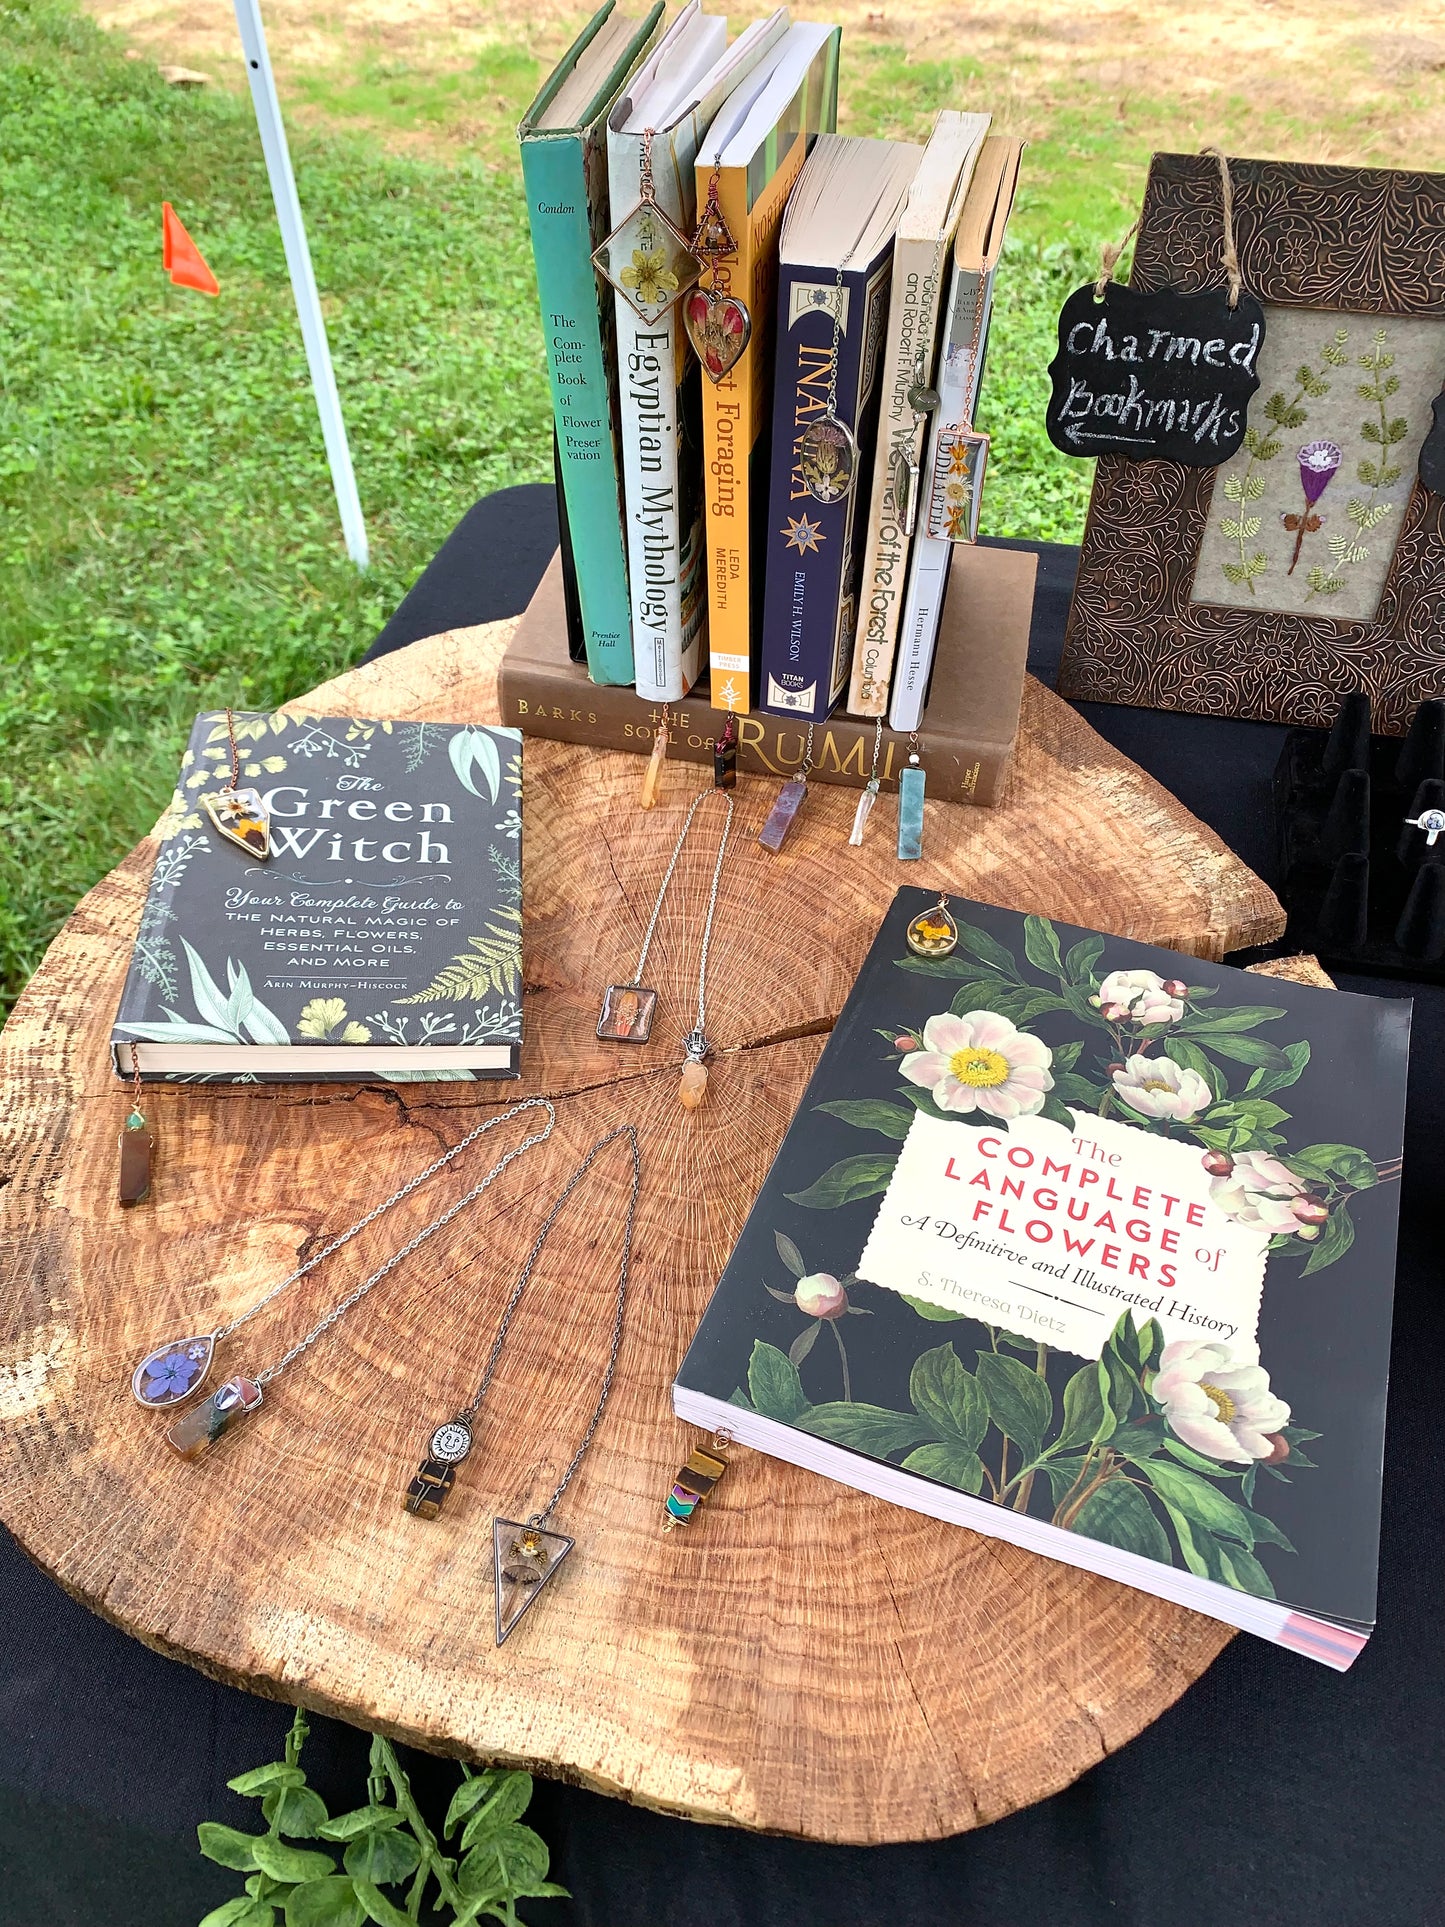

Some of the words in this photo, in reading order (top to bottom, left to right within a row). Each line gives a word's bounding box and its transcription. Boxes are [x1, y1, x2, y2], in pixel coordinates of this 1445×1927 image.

[538, 202, 575, 214] Condon
[904, 272, 919, 304] and
[550, 315, 576, 328] The
[900, 308, 918, 355] Robert
[553, 337, 587, 350] Com-
[1066, 317, 1260, 377] Charmed
[554, 353, 583, 366] plete
[557, 372, 587, 386] Book
[560, 394, 572, 406] of
[628, 329, 671, 473] Egyptian
[888, 369, 909, 422] Murphy
[1057, 374, 1240, 446] Bookmarks
[562, 416, 602, 428] Flower
[566, 436, 602, 448] Preser-
[567, 449, 601, 460] vation
[711, 401, 741, 517] Foraging
[929, 422, 958, 536] SDDHARTHA
[879, 525, 902, 549] of
[635, 484, 676, 633] Mythology
[729, 549, 740, 580] LEDA
[874, 551, 901, 587] the
[716, 547, 727, 610] MEREDITH
[793, 571, 805, 605] EMILY
[792, 606, 803, 617] H.
[866, 588, 896, 646] Forest
[592, 631, 621, 639] Prentice
[789, 619, 802, 662] WILSON
[911, 607, 929, 657] Hermann
[781, 679, 804, 689] BOOKS
[782, 673, 804, 683] TITAN
[861, 649, 880, 700] Columbia
[906, 661, 920, 691] Hesse
[518, 699, 598, 724] BARKS
[648, 708, 690, 729] THE
[736, 716, 896, 780] RUMI
[336, 774, 385, 792] The
[261, 786, 455, 823] Green
[269, 826, 453, 864] Witch
[224, 887, 287, 909] Your
[290, 892, 378, 913] Complete
[381, 896, 441, 914] Guide
[444, 898, 465, 911] to
[225, 912, 262, 922] THE
[270, 914, 357, 925] NATURAL
[364, 917, 428, 926] MAGIC
[435, 918, 460, 926] OF
[260, 928, 326, 939] HERBS,
[333, 930, 423, 940] FLOWERS,
[263, 942, 364, 953] ESSENTIAL
[371, 944, 417, 954] OILS,
[287, 957, 327, 967] AND
[333, 958, 391, 967] MORE
[263, 980, 294, 988] ARIN
[1071, 1137, 1122, 1167] The
[977, 1137, 1206, 1228] COMPLETE
[944, 1157, 1181, 1254] LANGUAGE
[1194, 1248, 1227, 1272] of
[972, 1200, 1178, 1288] FLOWERS
[900, 1215, 932, 1231] A
[934, 1220, 1028, 1265] Definitive
[1032, 1261, 1071, 1280] and
[1071, 1267, 1165, 1313] Illustrated
[1166, 1300, 1239, 1340] History
[917, 1271, 934, 1287] S.
[940, 1276, 1011, 1314] Theresa
[1017, 1303, 1067, 1334] Dietz
